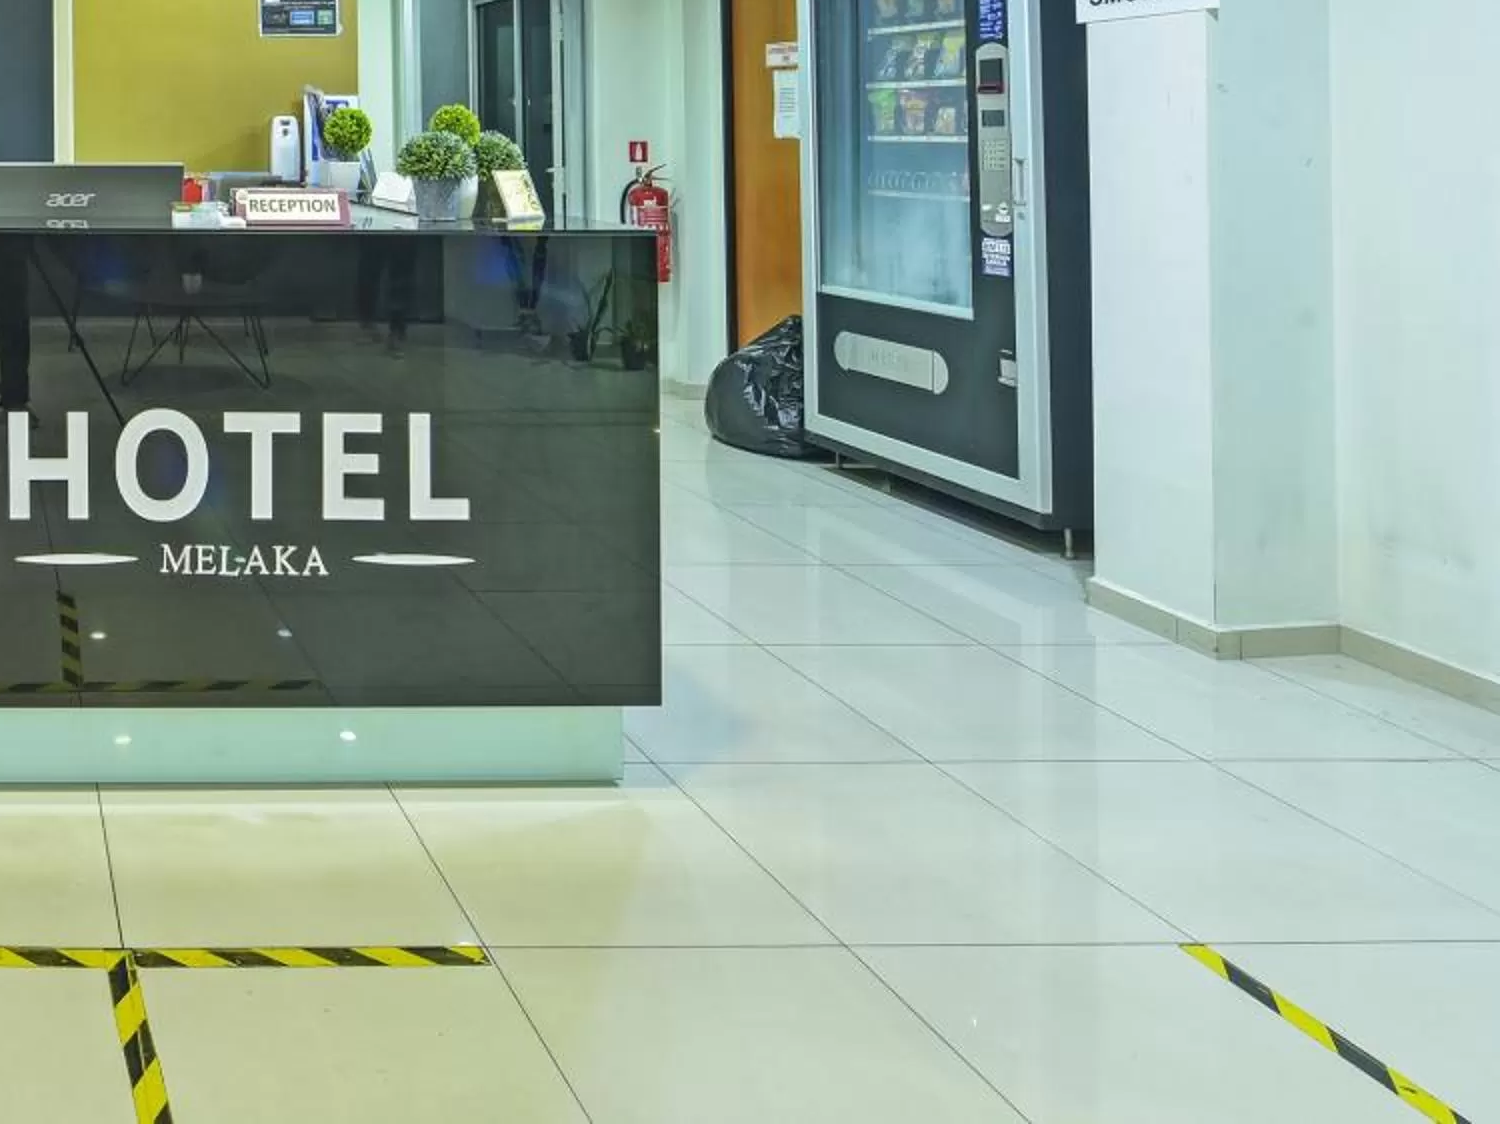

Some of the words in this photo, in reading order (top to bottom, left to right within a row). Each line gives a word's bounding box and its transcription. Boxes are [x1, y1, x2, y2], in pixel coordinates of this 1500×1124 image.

[46, 193, 96, 207] acer
[249, 199, 336, 213] RECEPTION
[7, 408, 471, 522] HOTEL
[160, 544, 329, 576] MELAKA
